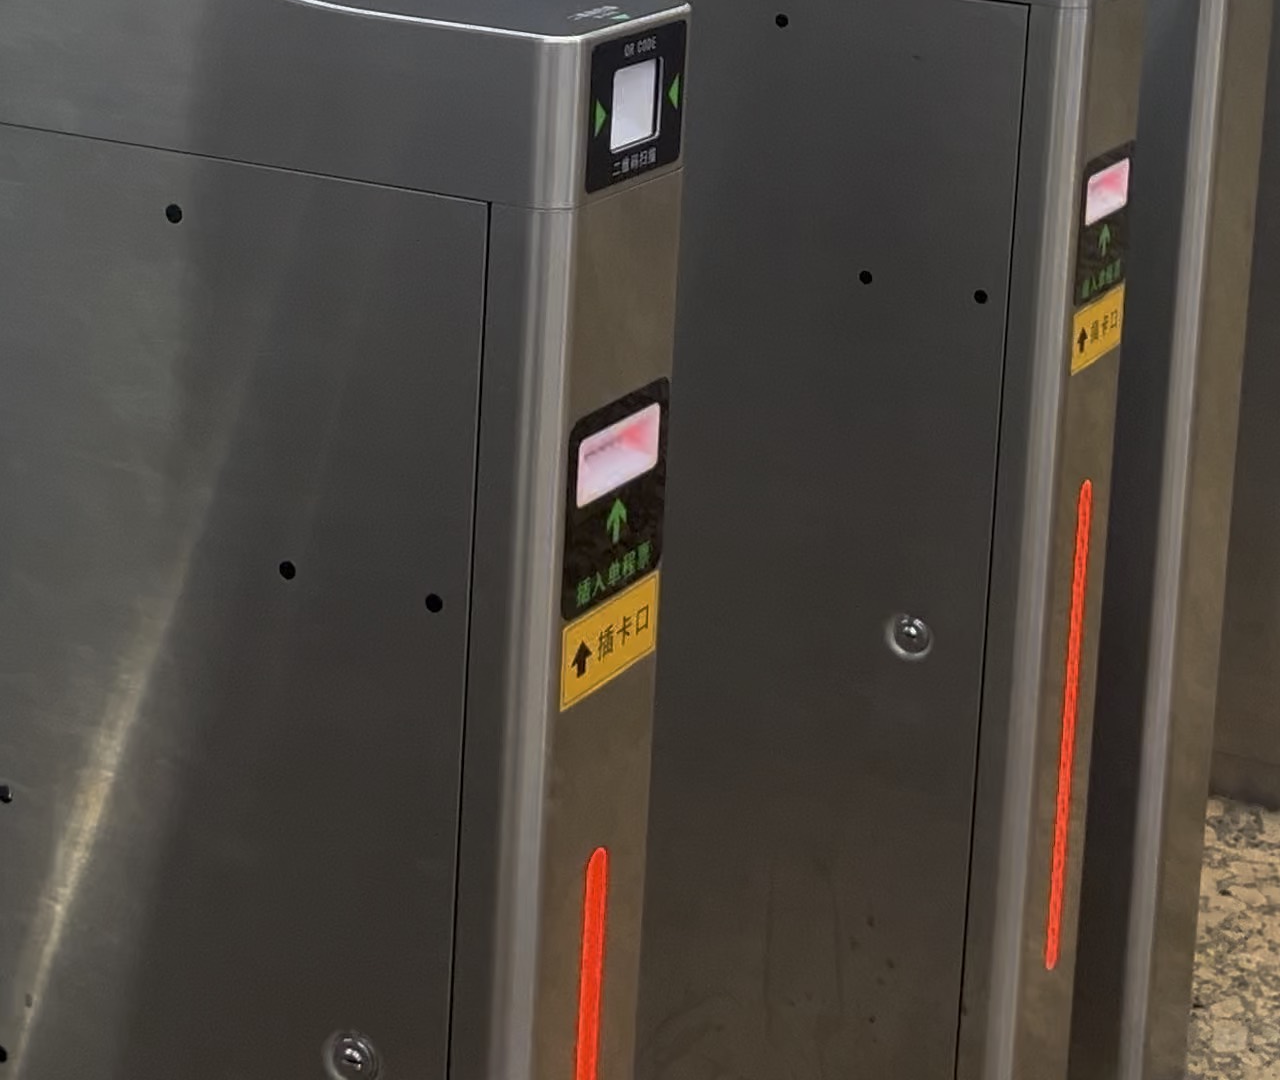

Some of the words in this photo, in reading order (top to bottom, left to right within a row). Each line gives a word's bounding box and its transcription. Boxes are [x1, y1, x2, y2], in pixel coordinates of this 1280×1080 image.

[637, 35, 657, 53] CODE
[575, 538, 653, 608] 插入单程票
[596, 604, 649, 663] 插卡口
